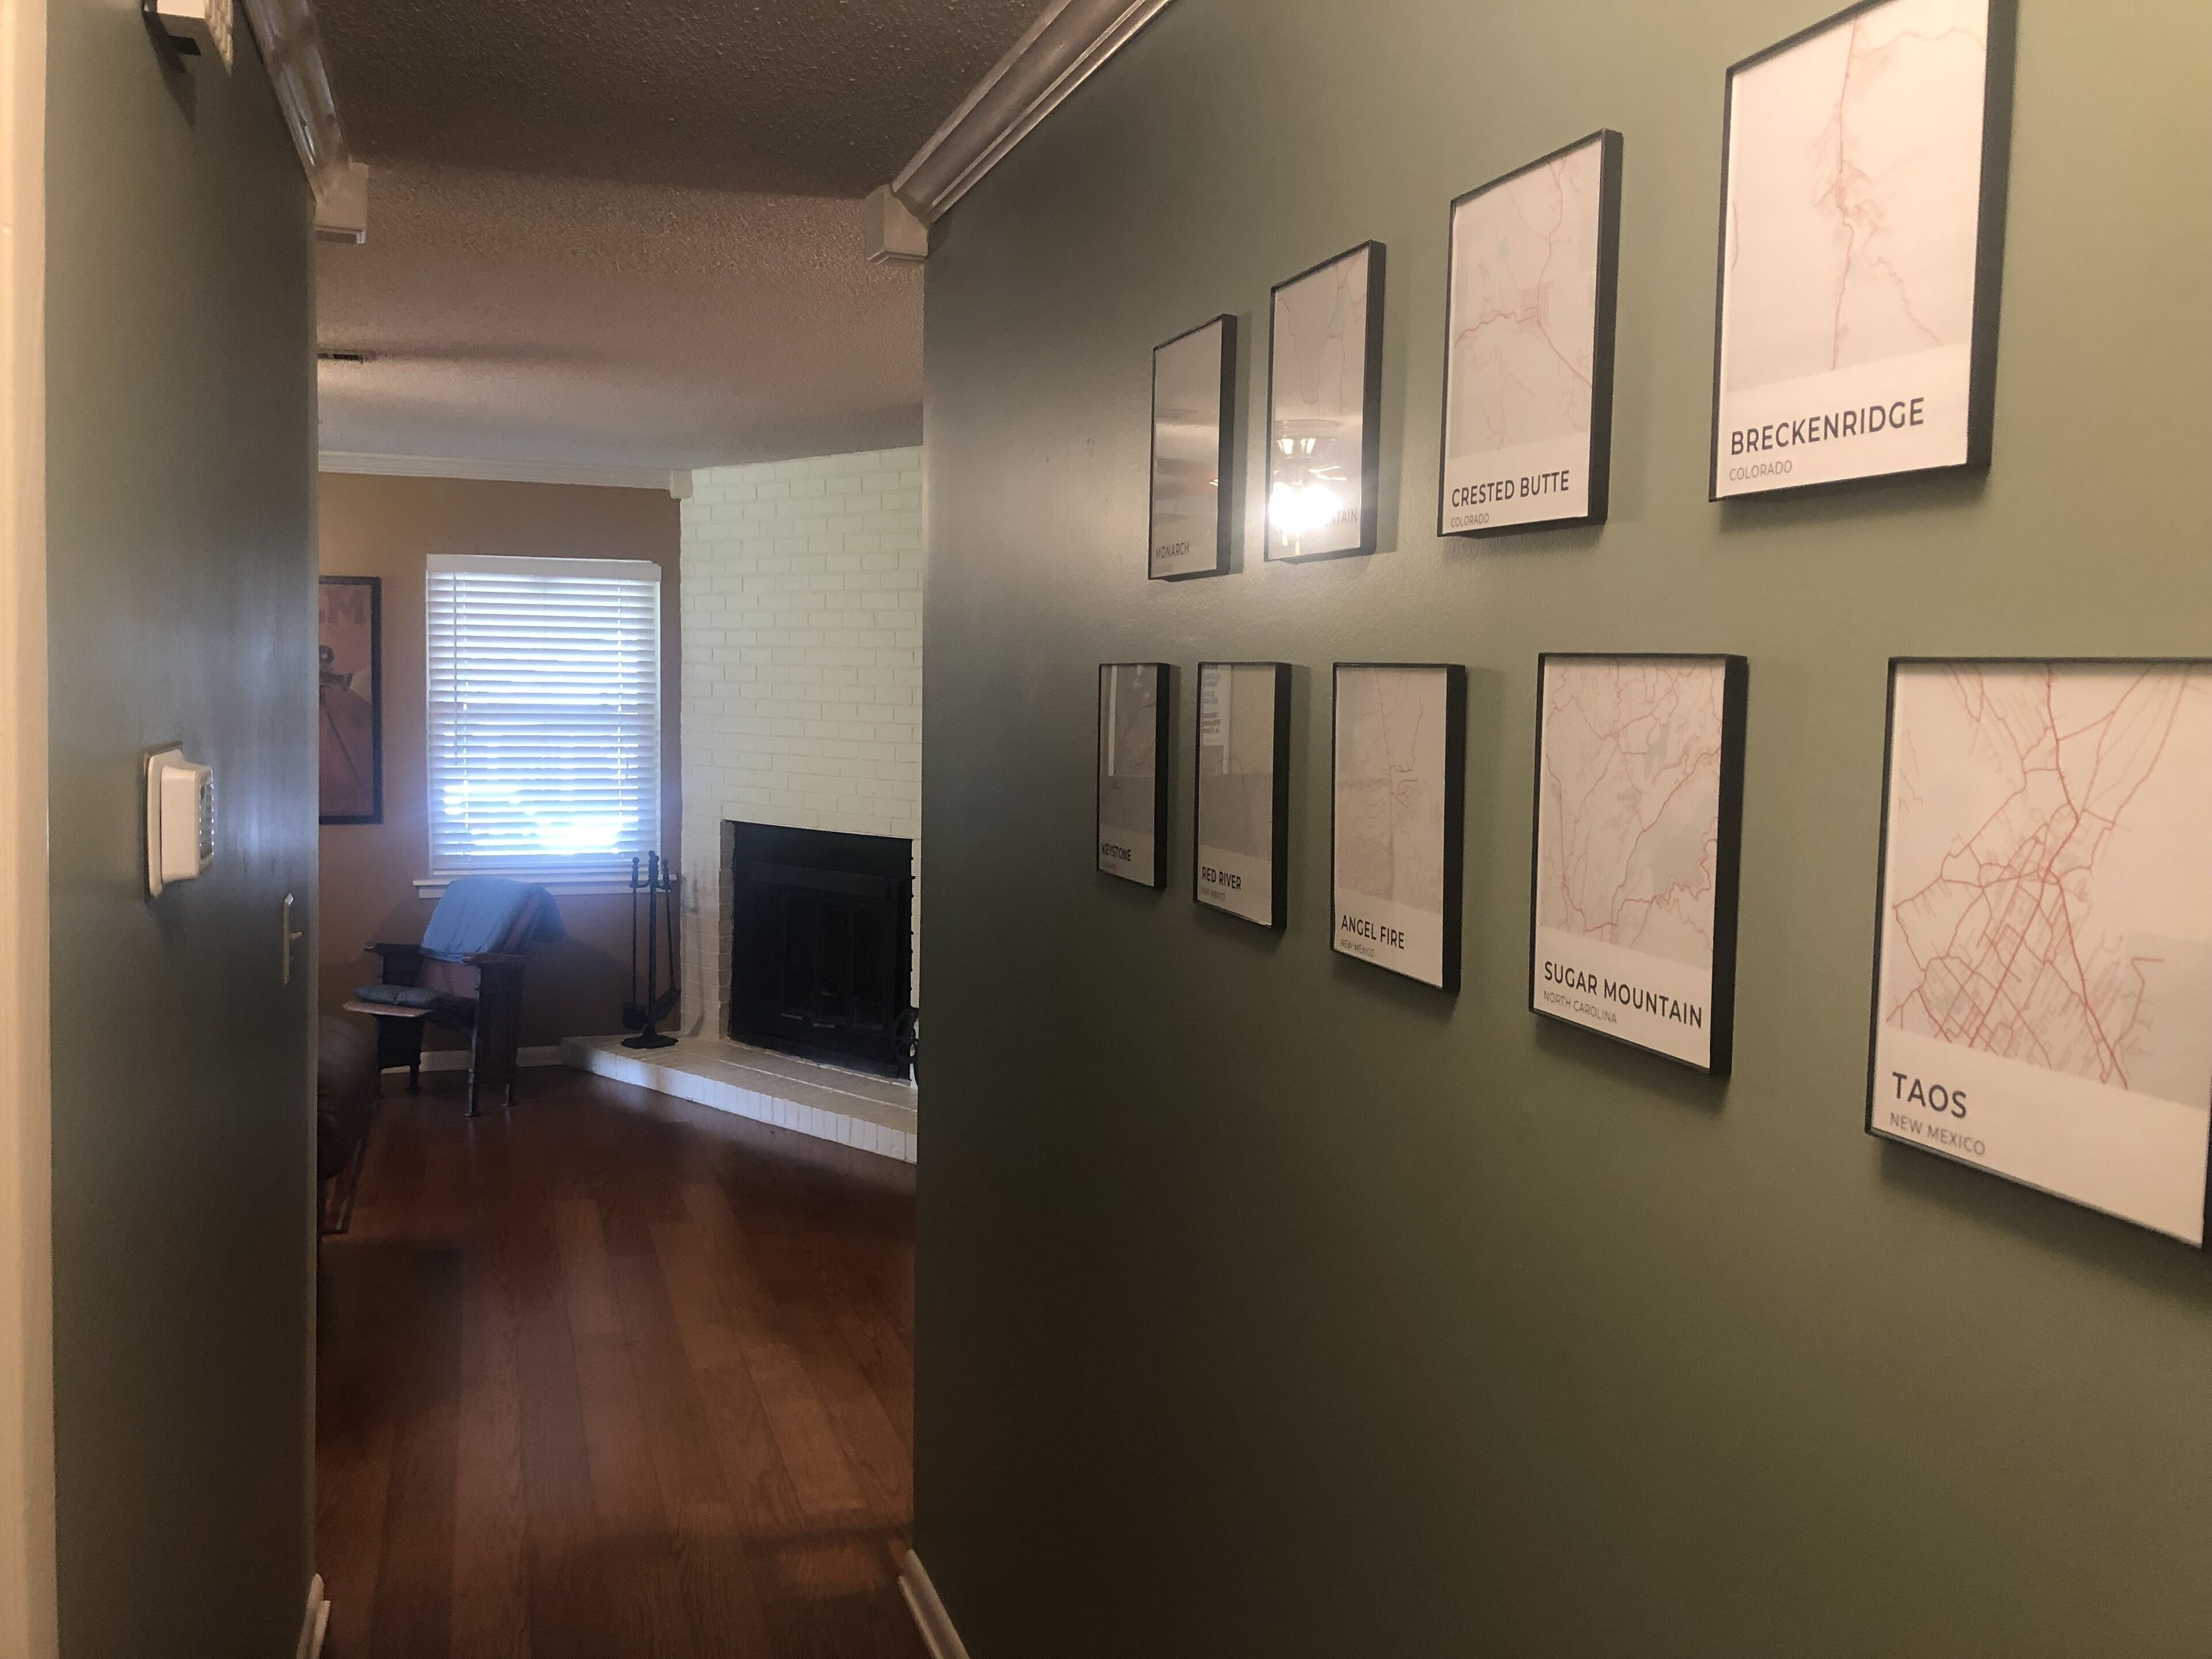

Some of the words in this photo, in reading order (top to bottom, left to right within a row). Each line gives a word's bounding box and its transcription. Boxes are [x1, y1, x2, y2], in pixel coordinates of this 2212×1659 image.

[1731, 397, 1925, 455] BRECKENRIDGE
[1729, 460, 1793, 481] COLORADO
[1452, 480, 1514, 507] CRESTED
[1520, 470, 1570, 497] BUTTE
[1450, 513, 1490, 528] COLORADO
[1156, 541, 1190, 559] MONARCH
[1102, 843, 1131, 861] KEYSTONE
[1202, 866, 1217, 883] RED
[1219, 871, 1241, 890] RIVER
[1340, 939, 1353, 949] NEW
[1354, 943, 1375, 957] MEXICO
[1341, 914, 1377, 940] ANGEL
[1380, 926, 1405, 950] FIRE
[1543, 990, 1571, 1009] NORTH
[1573, 1000, 1618, 1024] CAROLINA
[1544, 961, 1597, 995] SUGAR
[1604, 979, 1702, 1029] MOUNTAIN
[1892, 1071, 1967, 1118] TAOS
[1889, 1112, 1922, 1134] NEW
[1927, 1125, 1986, 1156] MEXICO
